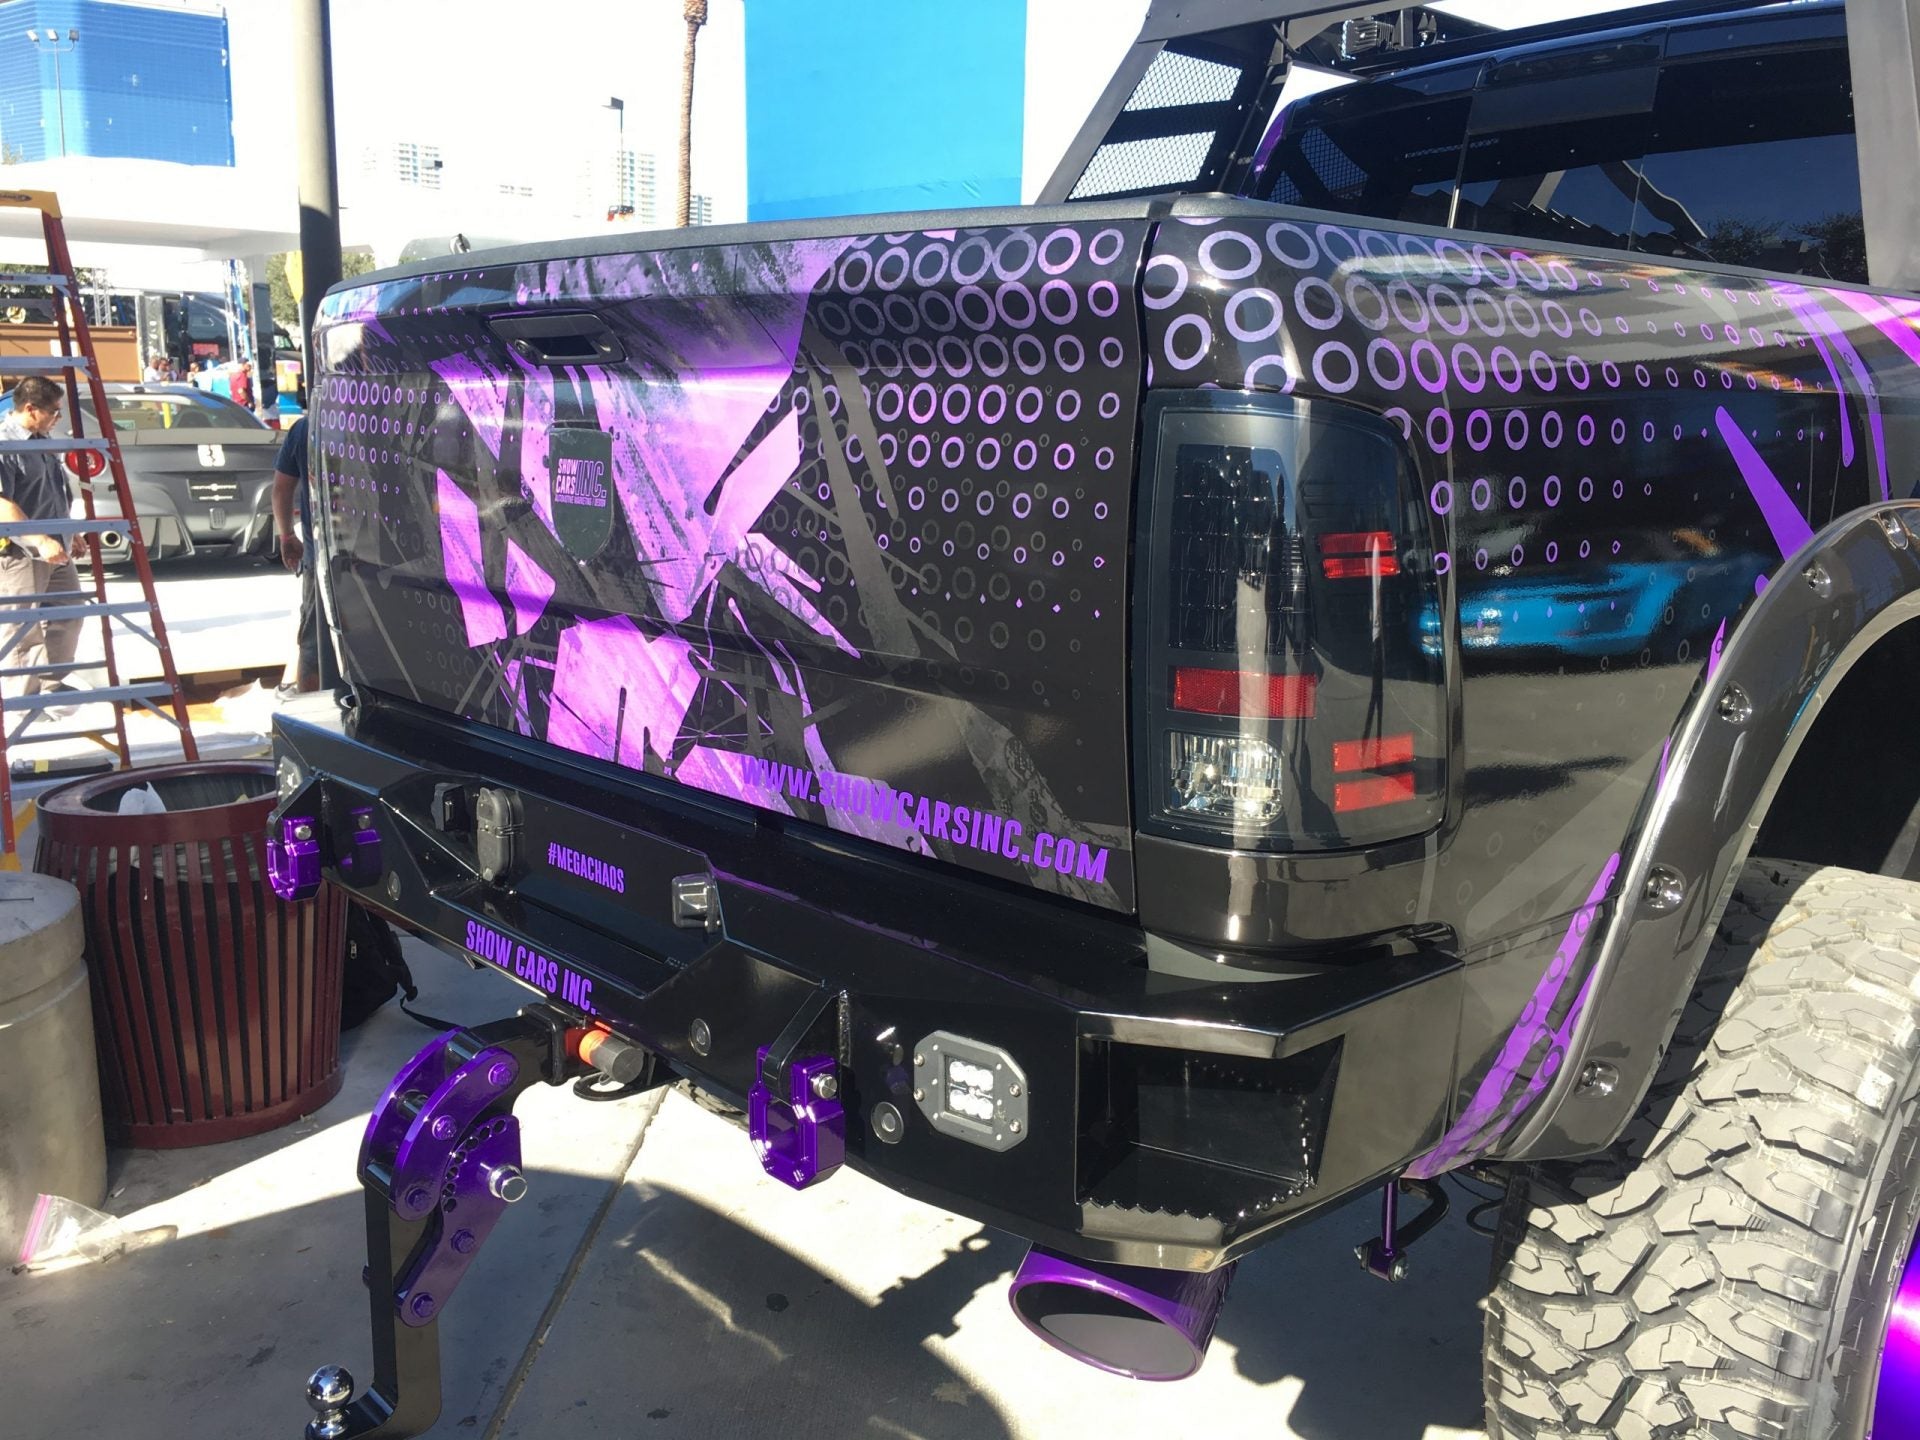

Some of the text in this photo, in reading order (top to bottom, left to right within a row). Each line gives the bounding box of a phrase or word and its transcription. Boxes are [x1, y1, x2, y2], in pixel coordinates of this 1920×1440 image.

[556, 475, 576, 495] CARS
[558, 458, 578, 475] SHOW
[740, 756, 1109, 884] WWW.SHOWCARSINC.COM
[547, 842, 625, 894] #MEGACHAOS
[465, 920, 597, 1015] SHOW CARS INC.
